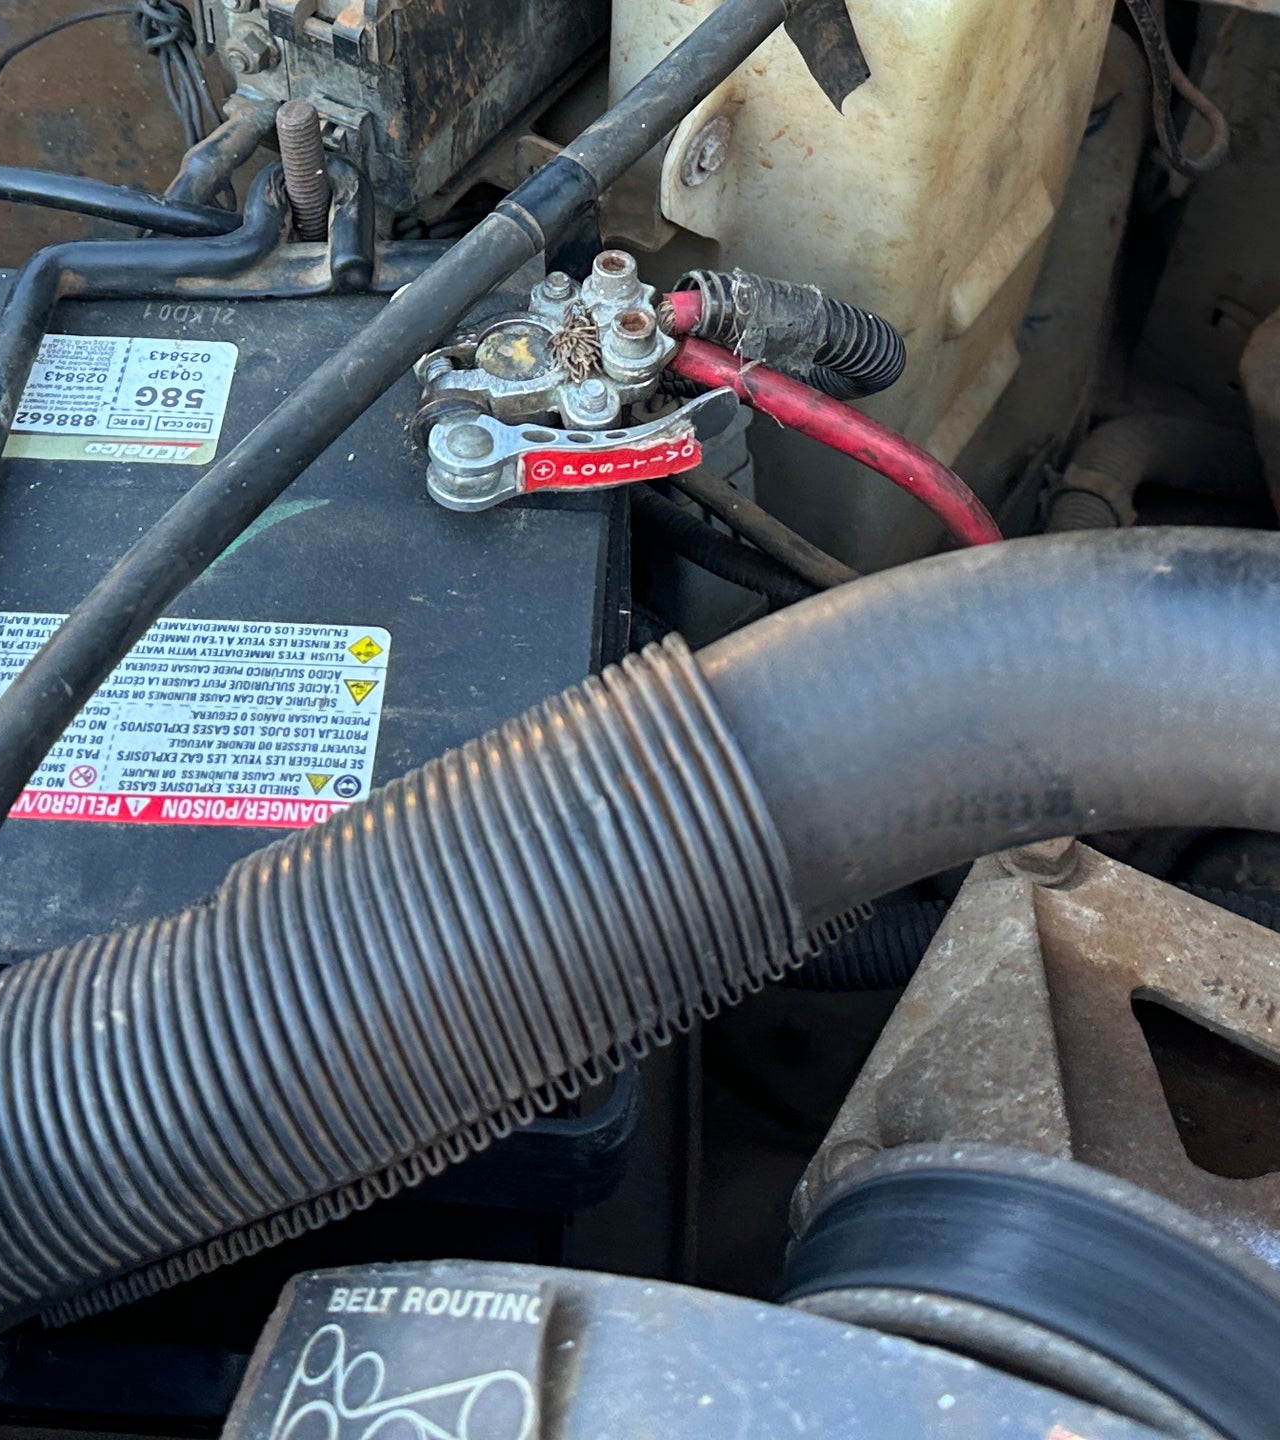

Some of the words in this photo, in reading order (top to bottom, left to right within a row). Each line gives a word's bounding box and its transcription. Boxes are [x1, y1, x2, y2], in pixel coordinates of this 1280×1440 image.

[148, 350, 211, 362] 025843
[43, 370, 107, 383] 025843
[132, 385, 206, 408] 58G
[14, 411, 97, 427] 888662
[83, 442, 201, 460] ACDelco
[563, 444, 695, 475] POSITIVO
[6, 628, 23, 636] UN
[242, 624, 271, 634] OJOS
[273, 625, 295, 635] LOS
[298, 626, 348, 636] ENJUAGE
[192, 635, 223, 644] L'EAU
[236, 636, 266, 646] YEUX
[267, 637, 287, 646] LES
[289, 638, 330, 648] RINSER
[333, 640, 346, 649] SE
[167, 646, 197, 656] WITH
[199, 647, 274, 658] IMMEDIATELY
[277, 650, 305, 660] EYES
[310, 652, 344, 661] FLUSH
[123, 662, 169, 672] CEGUERA
[170, 663, 210, 674] CAUSAR
[212, 665, 243, 675] PUEDE
[245, 666, 305, 679] SULFÚRICO
[111, 675, 145, 687] CÉCITÉ
[146, 677, 159, 686] LA
[161, 677, 200, 687] CAUSER
[202, 678, 226, 688] PEUT
[228, 679, 296, 692] SULFURIQUE
[131, 690, 145, 699] OR
[198, 692, 231, 702] CAUSE
[232, 693, 254, 703] CAN
[256, 694, 283, 705] ACID
[284, 695, 337, 707] SULFURIC
[189, 709, 237, 720] CEGUERA.
[239, 711, 247, 720] O
[250, 711, 285, 723] DAÑOS
[287, 713, 328, 723] CAUSAR
[330, 715, 370, 725] PUEDEN
[88, 719, 107, 730] NO
[119, 721, 190, 733] EXPLOSIVOS
[191, 723, 230, 734] GASES
[232, 725, 254, 735] LOS
[257, 726, 290, 736] OJOS.
[293, 727, 314, 737] LOS
[317, 728, 369, 740] PROTEJA
[89, 735, 103, 744] DE
[166, 737, 214, 748] AVEUGLE.
[216, 740, 255, 749] RENDRE
[274, 741, 318, 752] BLESSER
[320, 743, 366, 754] PEUVENT
[75, 748, 100, 758] PAS
[115, 750, 178, 762] EXPLOSIFS
[179, 752, 203, 762] GAZ
[206, 753, 227, 763] LES
[264, 754, 285, 765] LES
[349, 758, 364, 768] SE
[120, 767, 160, 778] INJURY.
[160, 769, 176, 778] OR
[180, 768, 238, 781] BLINDNESS
[240, 770, 275, 781] CAUSE
[279, 772, 301, 783] CAN
[45, 777, 65, 787] NO
[117, 780, 157, 791] GASES
[159, 780, 221, 793] EXPLOSIVE
[224, 782, 256, 793] EYES.
[258, 783, 299, 795] SHIELD
[10, 791, 122, 815] PELIGRO/V
[160, 795, 328, 823] DANGER/POISON
[328, 1286, 398, 1313] BELT
